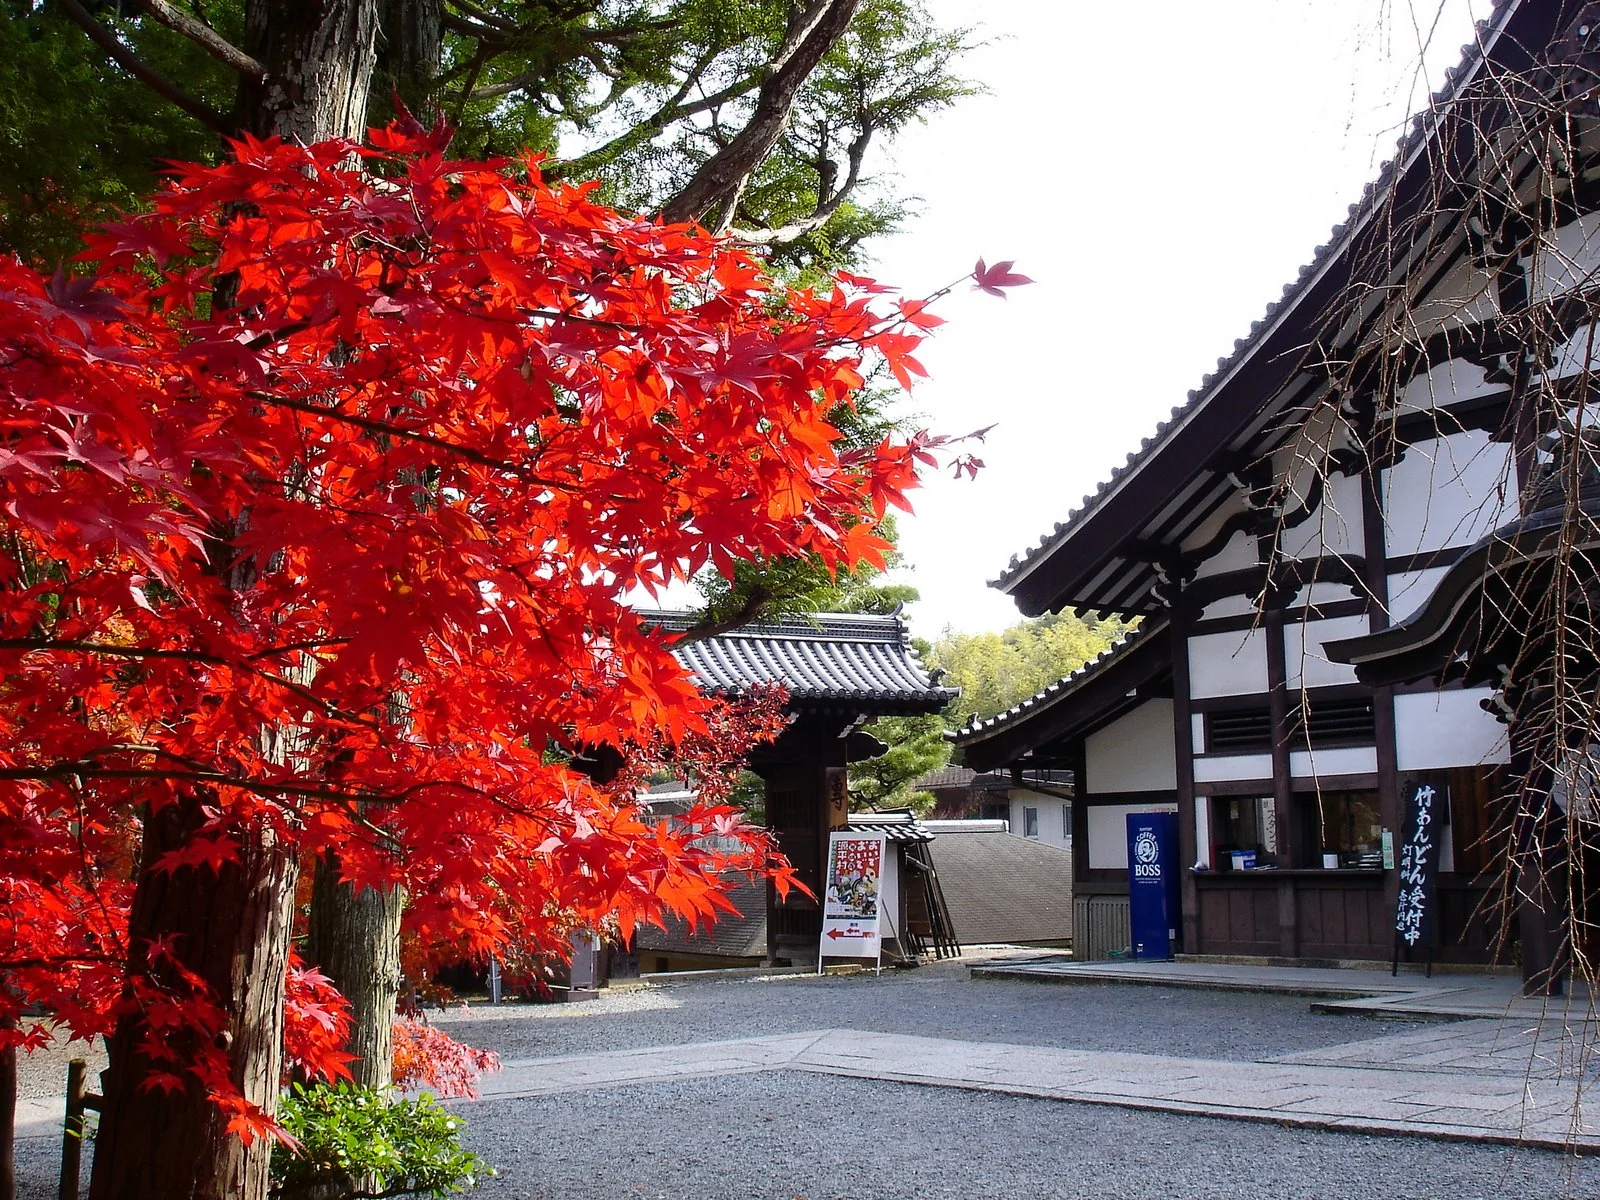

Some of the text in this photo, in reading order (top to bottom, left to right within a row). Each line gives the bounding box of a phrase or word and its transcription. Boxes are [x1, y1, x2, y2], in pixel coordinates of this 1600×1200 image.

[1136, 832, 1156, 841] COFFEE
[1135, 864, 1160, 876] BOSS
[1404, 785, 1436, 946] 竹あんどん受付中
